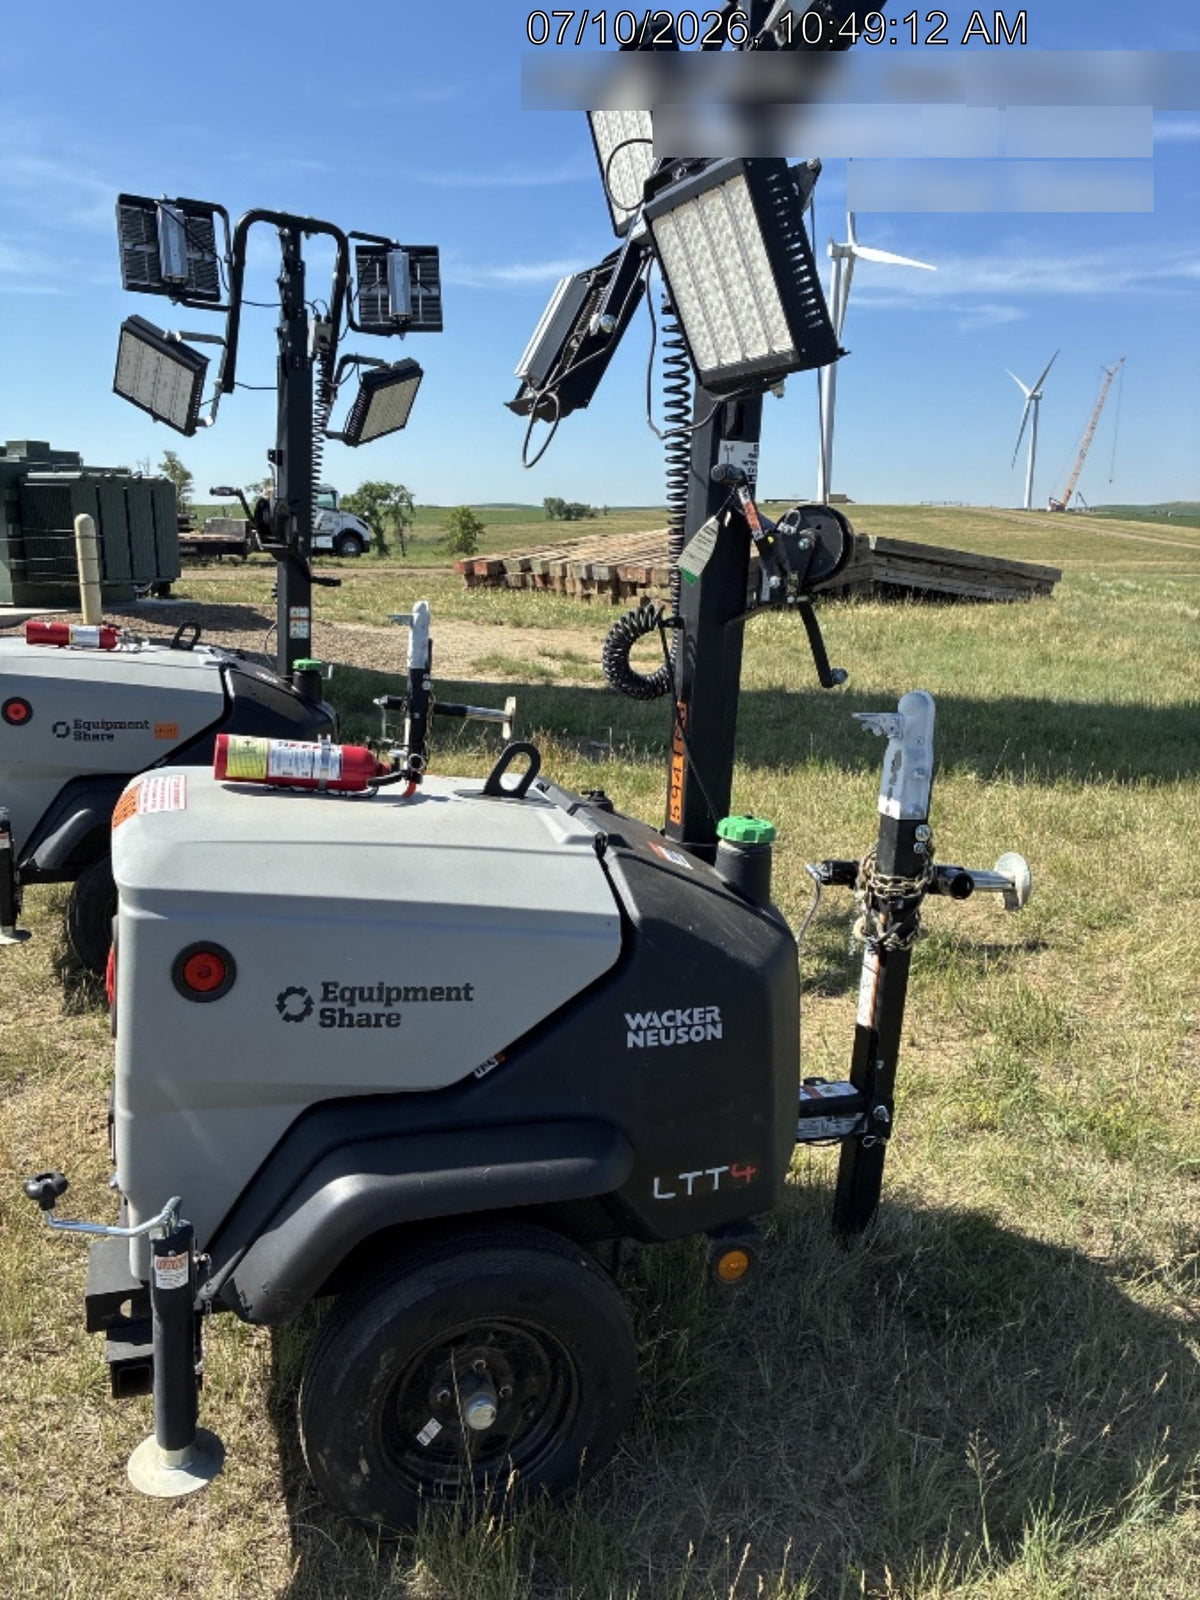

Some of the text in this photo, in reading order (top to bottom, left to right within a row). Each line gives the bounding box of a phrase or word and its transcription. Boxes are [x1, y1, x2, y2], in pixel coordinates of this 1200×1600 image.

[73, 719, 150, 731] Equipment
[73, 731, 115, 742] Share
[320, 981, 475, 1007] Equipment
[319, 1007, 402, 1028] Share
[624, 1005, 722, 1030] WACKER
[626, 1023, 723, 1048] NEUSON
